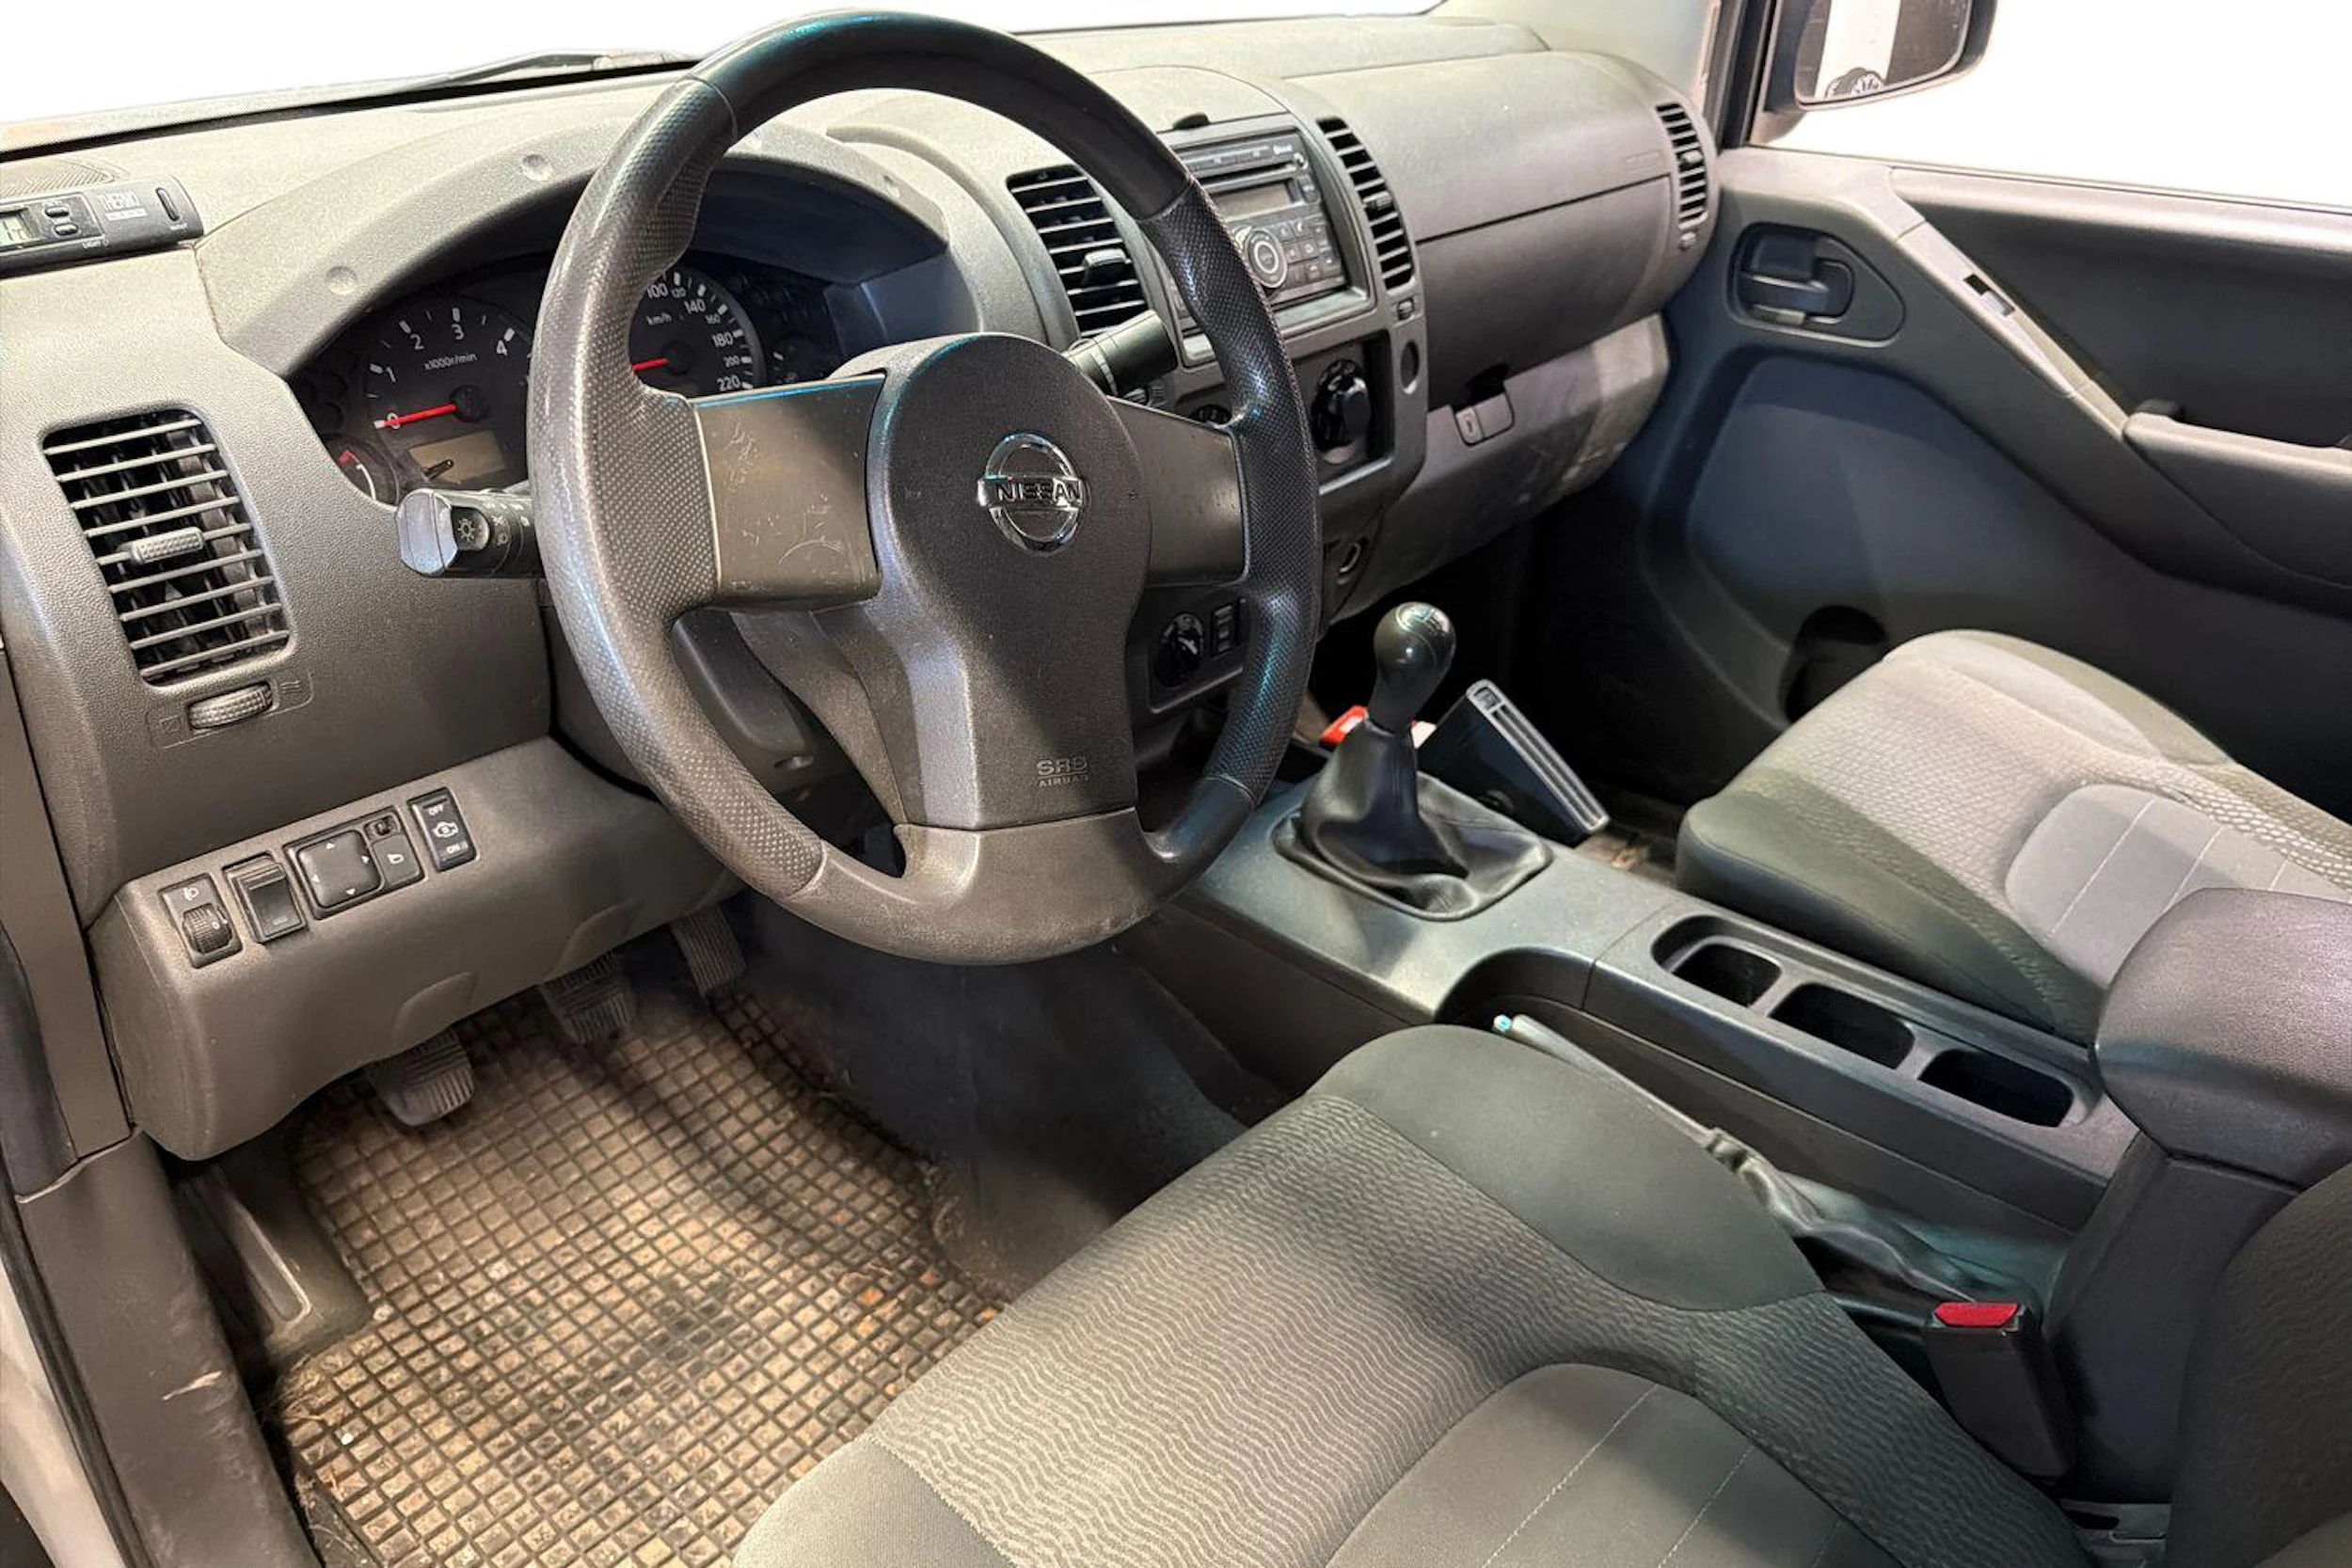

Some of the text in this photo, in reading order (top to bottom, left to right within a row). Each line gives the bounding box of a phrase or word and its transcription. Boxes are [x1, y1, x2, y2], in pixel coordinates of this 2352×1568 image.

[646, 282, 669, 299] 100
[671, 287, 687, 298] 120
[684, 298, 707, 314] 140
[646, 312, 673, 325] km/h
[706, 314, 722, 325] 160
[451, 323, 465, 340] 3
[712, 331, 734, 347] 180
[410, 333, 424, 350] 2
[496, 339, 508, 356] 4
[723, 356, 740, 368] 200
[386, 366, 396, 382] 1
[716, 374, 741, 391] 220
[387, 411, 401, 429] 0
[996, 477, 1082, 506] NISSAN
[428, 803, 444, 816] OFF
[446, 843, 461, 854] ON
